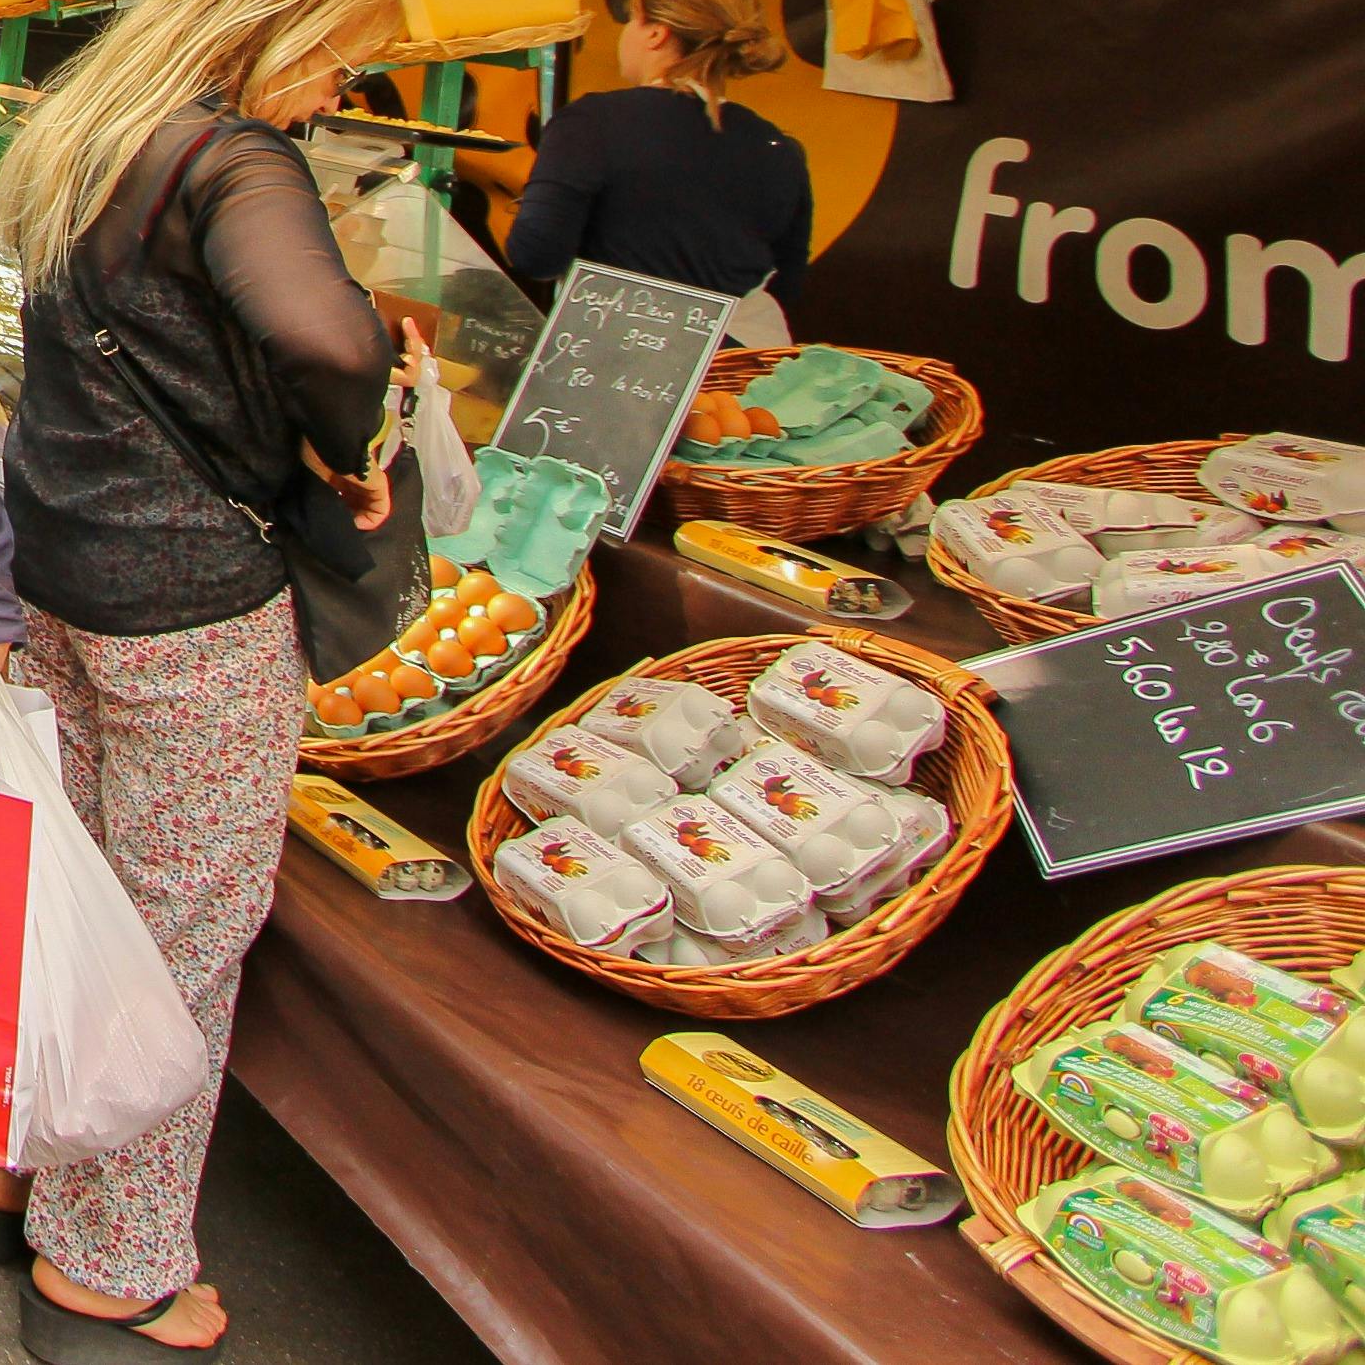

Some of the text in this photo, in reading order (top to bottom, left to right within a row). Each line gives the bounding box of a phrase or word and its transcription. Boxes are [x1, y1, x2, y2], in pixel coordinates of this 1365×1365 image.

[1176, 619, 1239, 667] 2,80
[1246, 719, 1295, 744] 6
[1261, 596, 1353, 683] Oeufs
[1104, 635, 1174, 701] 5,60
[1178, 744, 1233, 791] 12
[782, 756, 799, 766] La
[701, 803, 718, 816] La
[685, 1072, 706, 1094] 18
[705, 1088, 747, 1121] œufs
[747, 1113, 770, 1135] de
[771, 1130, 816, 1167] caille
